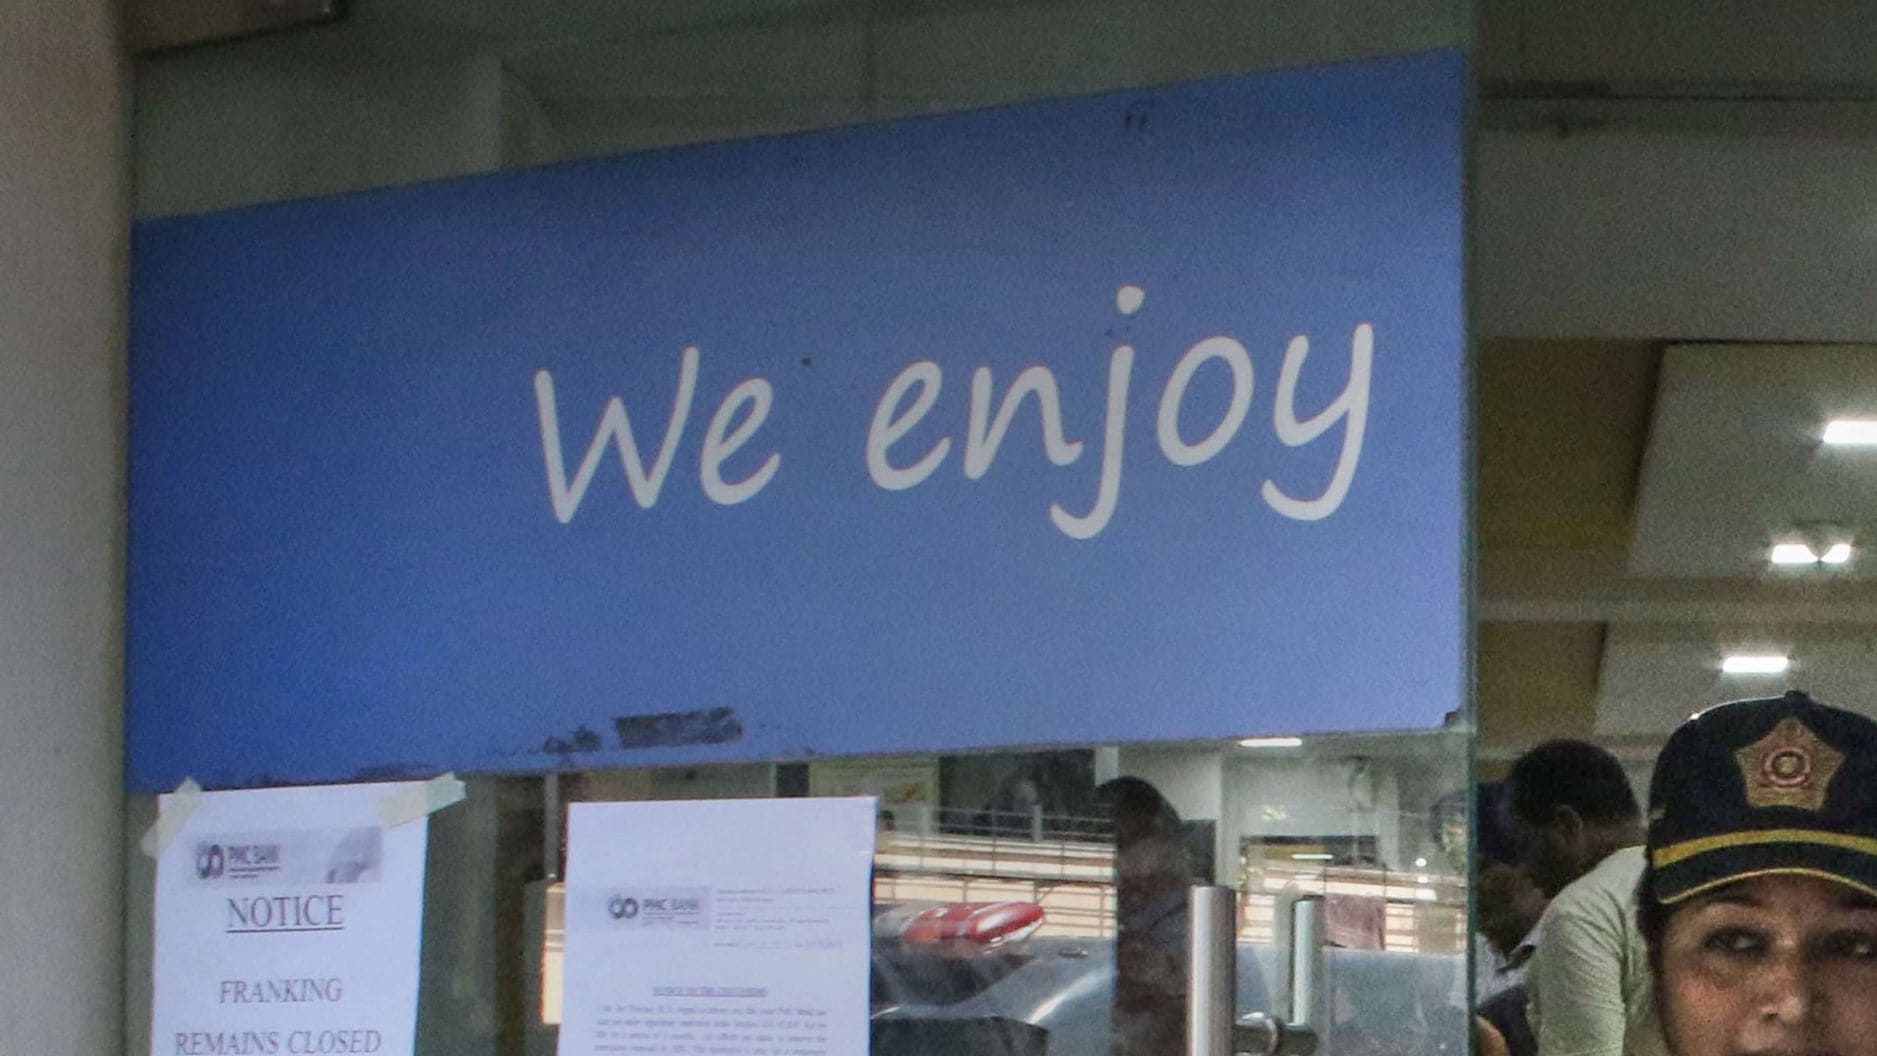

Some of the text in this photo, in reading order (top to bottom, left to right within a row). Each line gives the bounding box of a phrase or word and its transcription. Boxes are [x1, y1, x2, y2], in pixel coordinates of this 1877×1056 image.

[533, 285, 1373, 540] We enjoy
[226, 894, 345, 929] NOTICE
[220, 978, 344, 1004] FRANKING
[174, 1029, 382, 1056] REMAINS CLOSED
